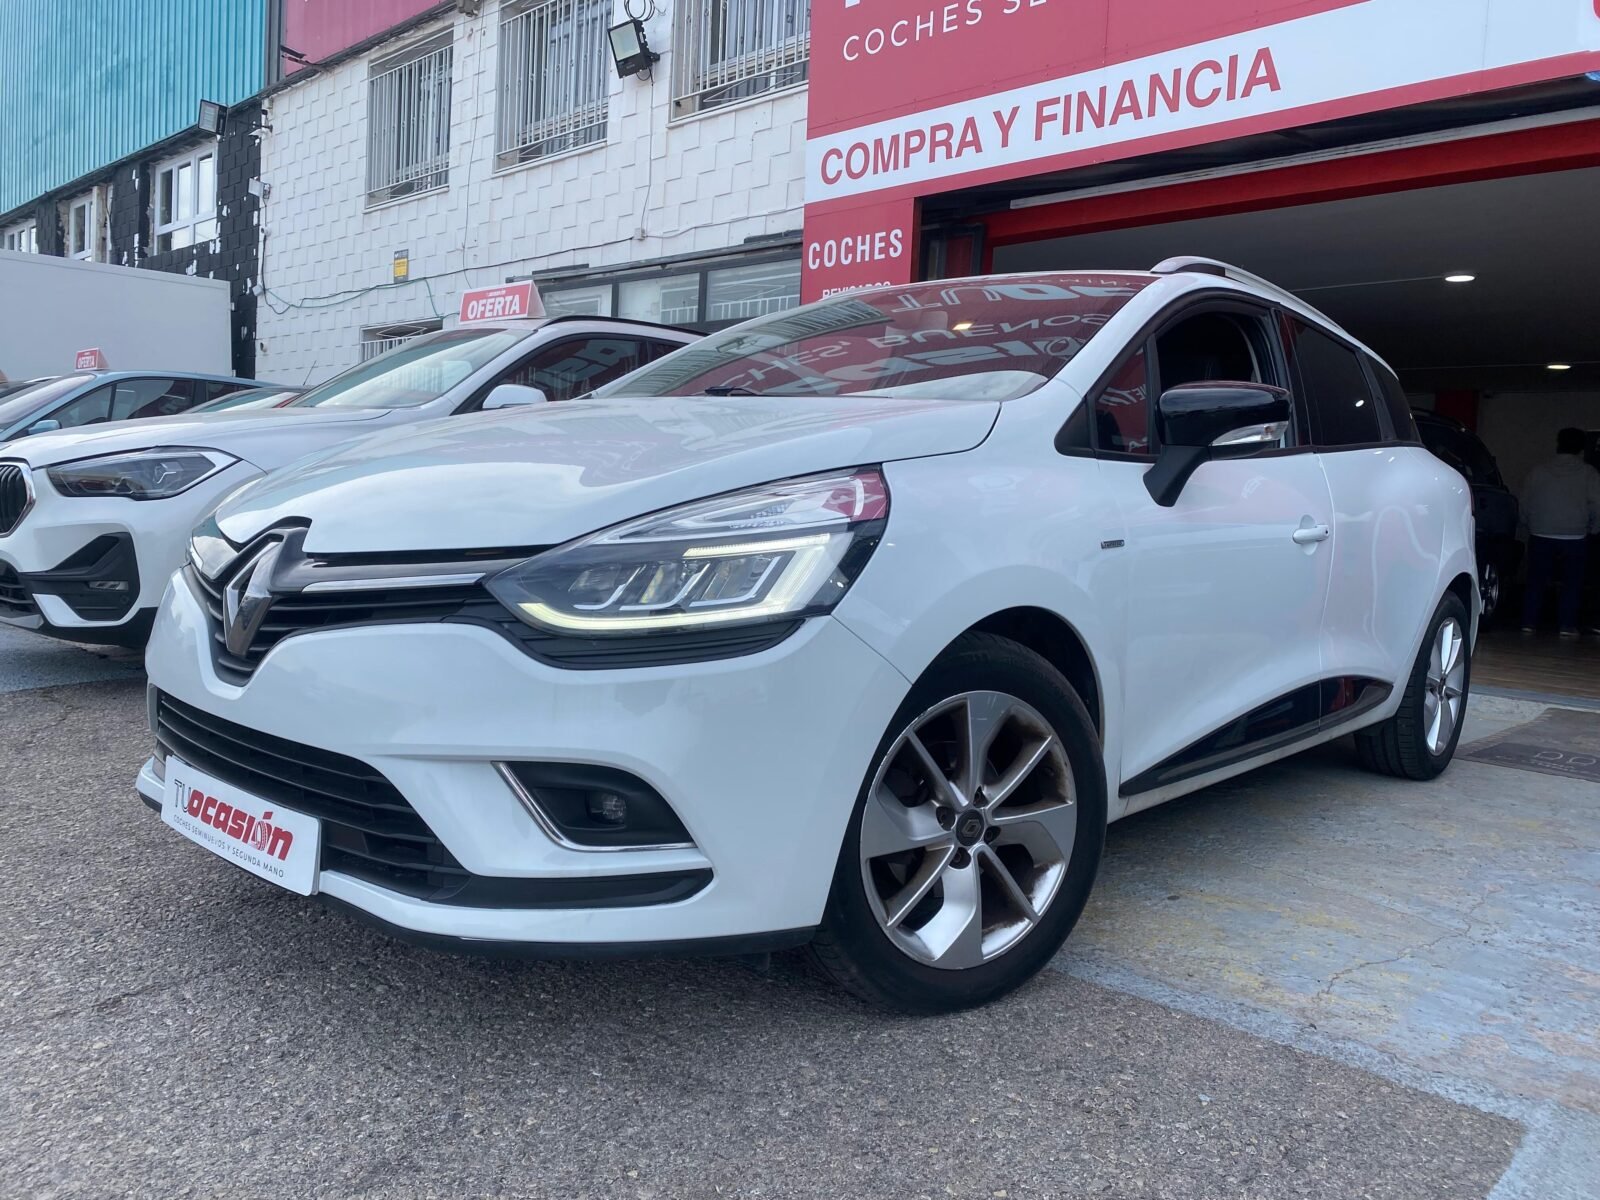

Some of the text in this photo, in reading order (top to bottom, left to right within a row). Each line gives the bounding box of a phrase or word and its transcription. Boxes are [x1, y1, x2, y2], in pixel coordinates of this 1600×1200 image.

[843, 0, 983, 61] COCHES
[820, 46, 1281, 185] COMPRA Y FINANCIA
[808, 229, 903, 270] COCHES
[467, 294, 520, 320] OFERTA
[232, 847, 261, 867] SEGUNDA
[263, 861, 284, 878] MANO
